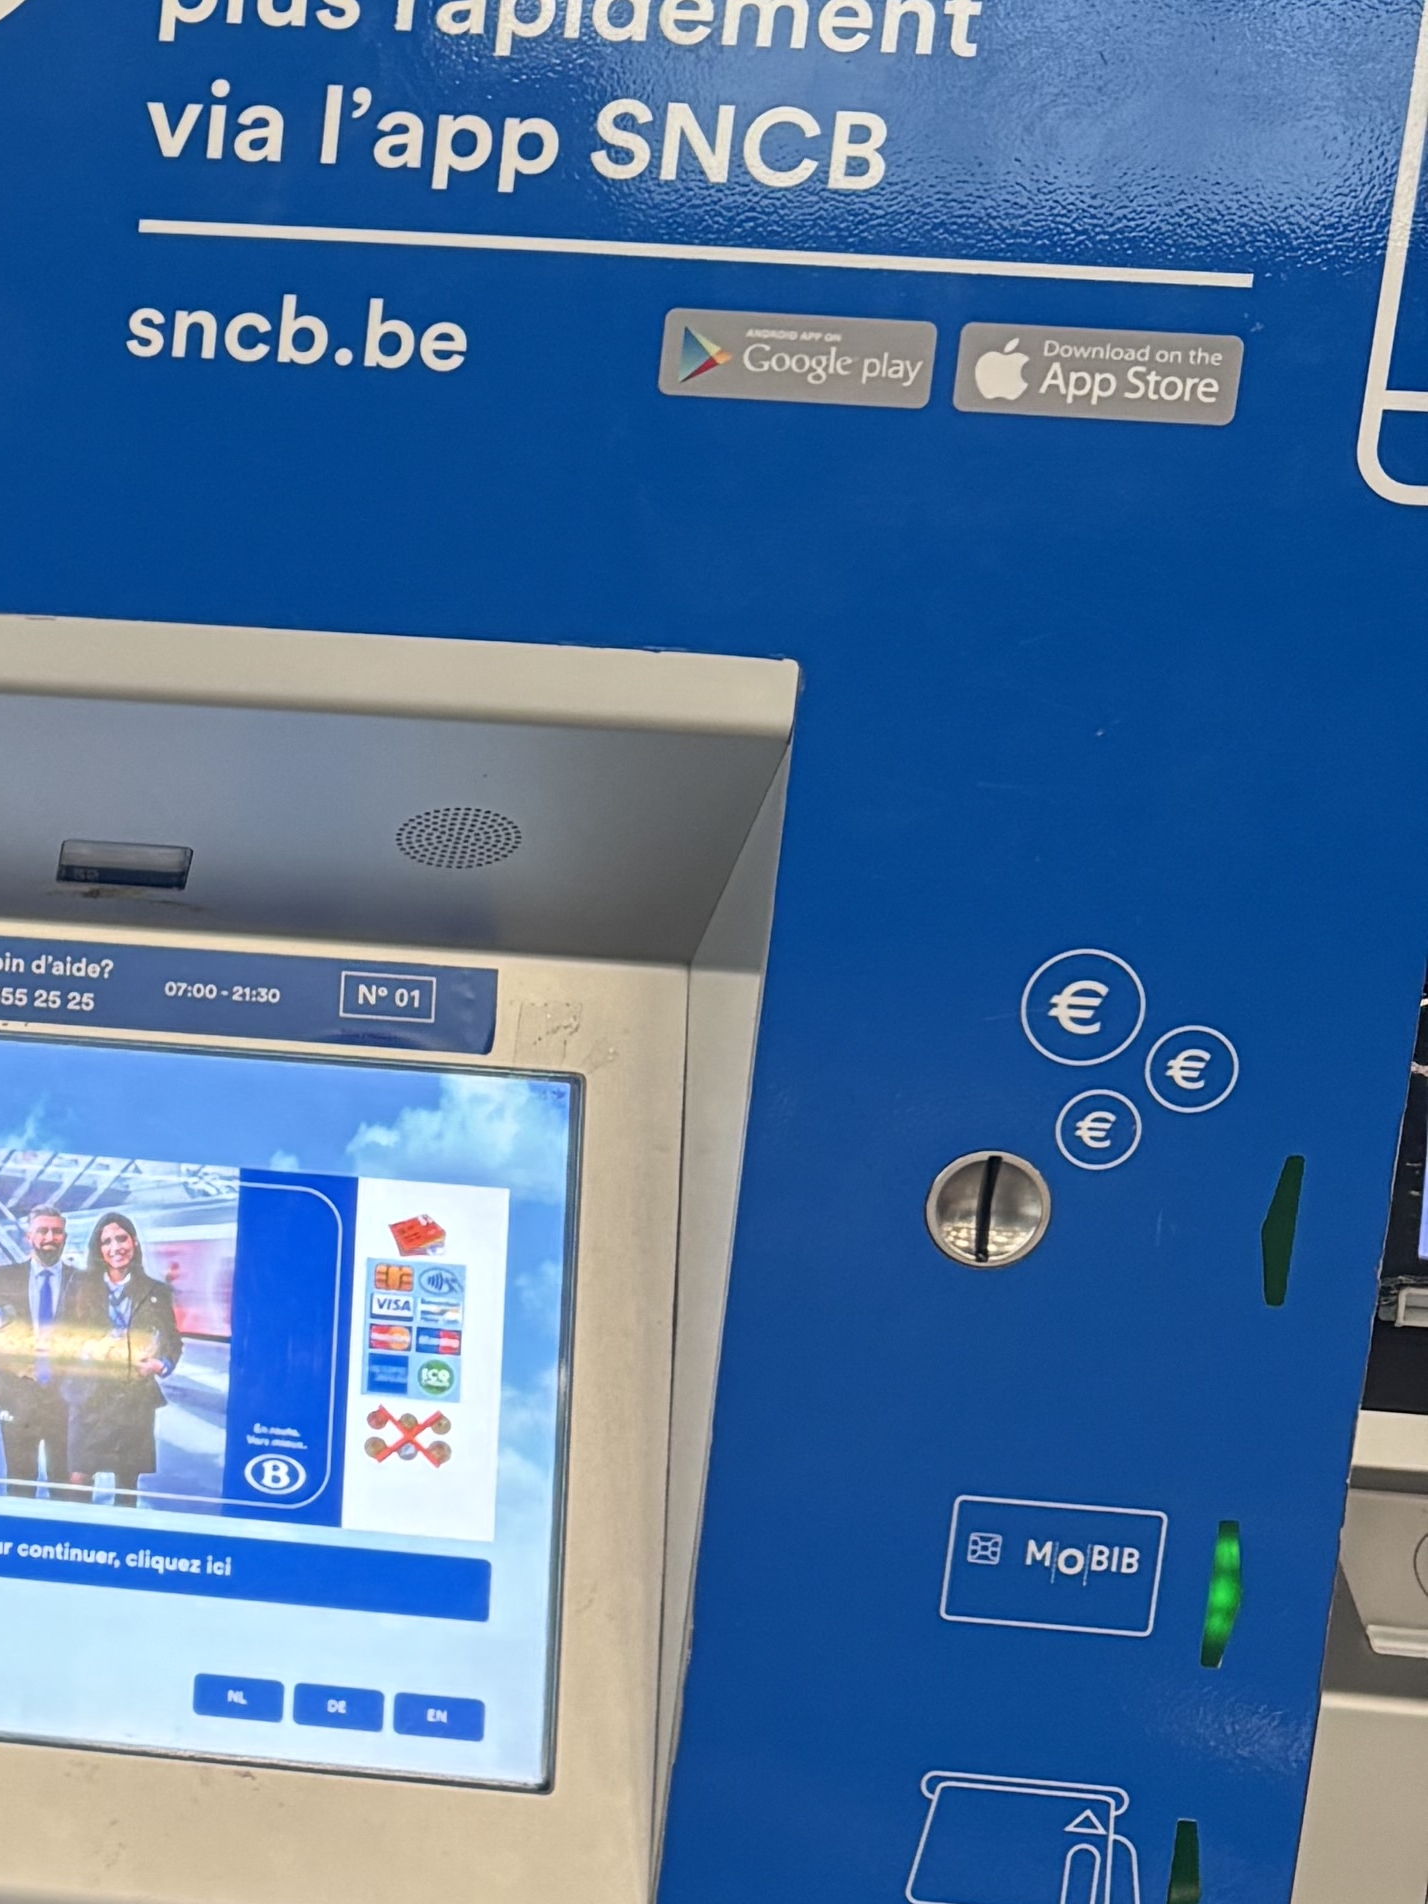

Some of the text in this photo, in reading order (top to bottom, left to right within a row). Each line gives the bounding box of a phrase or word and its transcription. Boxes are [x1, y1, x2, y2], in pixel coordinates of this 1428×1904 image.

[146, 79, 287, 165] via
[589, 97, 890, 191] SNCB
[125, 294, 468, 374] sncb.be
[743, 343, 923, 386] Google play
[1044, 340, 1223, 366] Download on the
[1039, 361, 1220, 405] App Store
[34, 989, 61, 1009] 25
[67, 992, 95, 1011] 25
[164, 981, 217, 1000] 07:00
[231, 986, 281, 1004] 21:30
[394, 988, 421, 1008] 01
[377, 1297, 412, 1312] VISA
[17, 1541, 120, 1568] continuer,
[125, 1549, 201, 1575] cliquez
[206, 1555, 232, 1576] ici
[227, 1689, 248, 1705] NL
[326, 1699, 347, 1714] DE
[426, 1708, 448, 1723] EN
